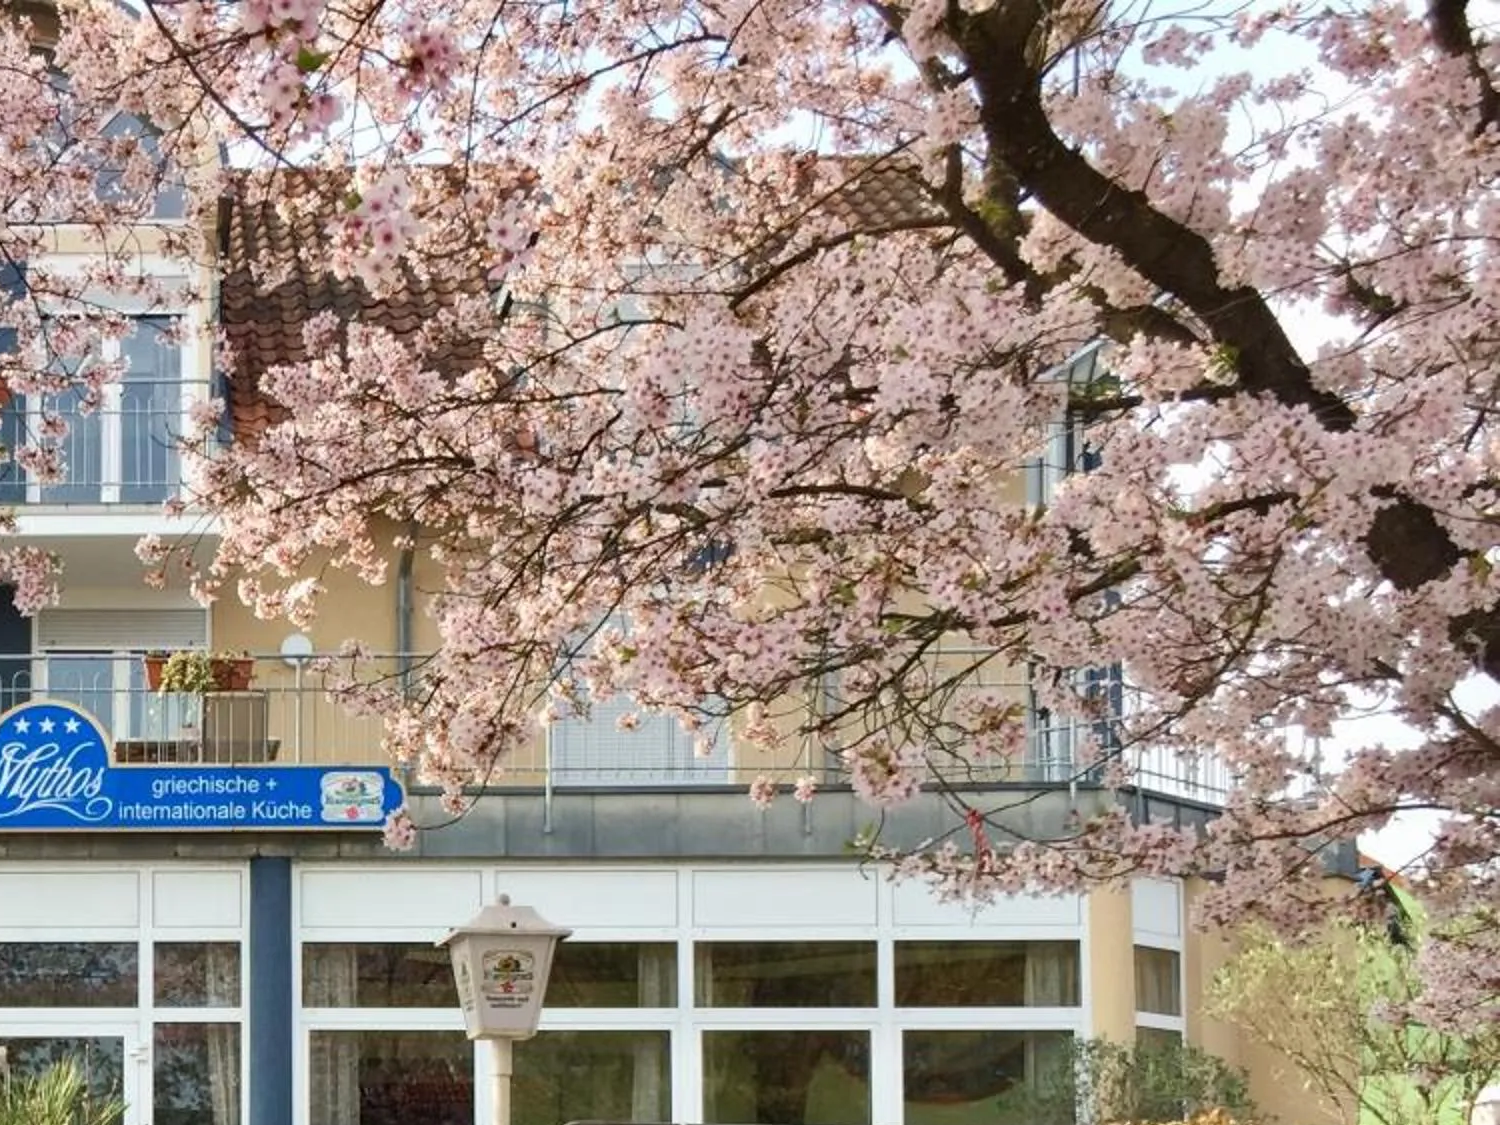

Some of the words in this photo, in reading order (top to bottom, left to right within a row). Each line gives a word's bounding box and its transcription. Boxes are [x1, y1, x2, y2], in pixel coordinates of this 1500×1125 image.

[151, 775, 260, 799] griechische
[265, 778, 277, 792] +
[118, 801, 247, 820] internationale
[251, 800, 313, 820] Küche
